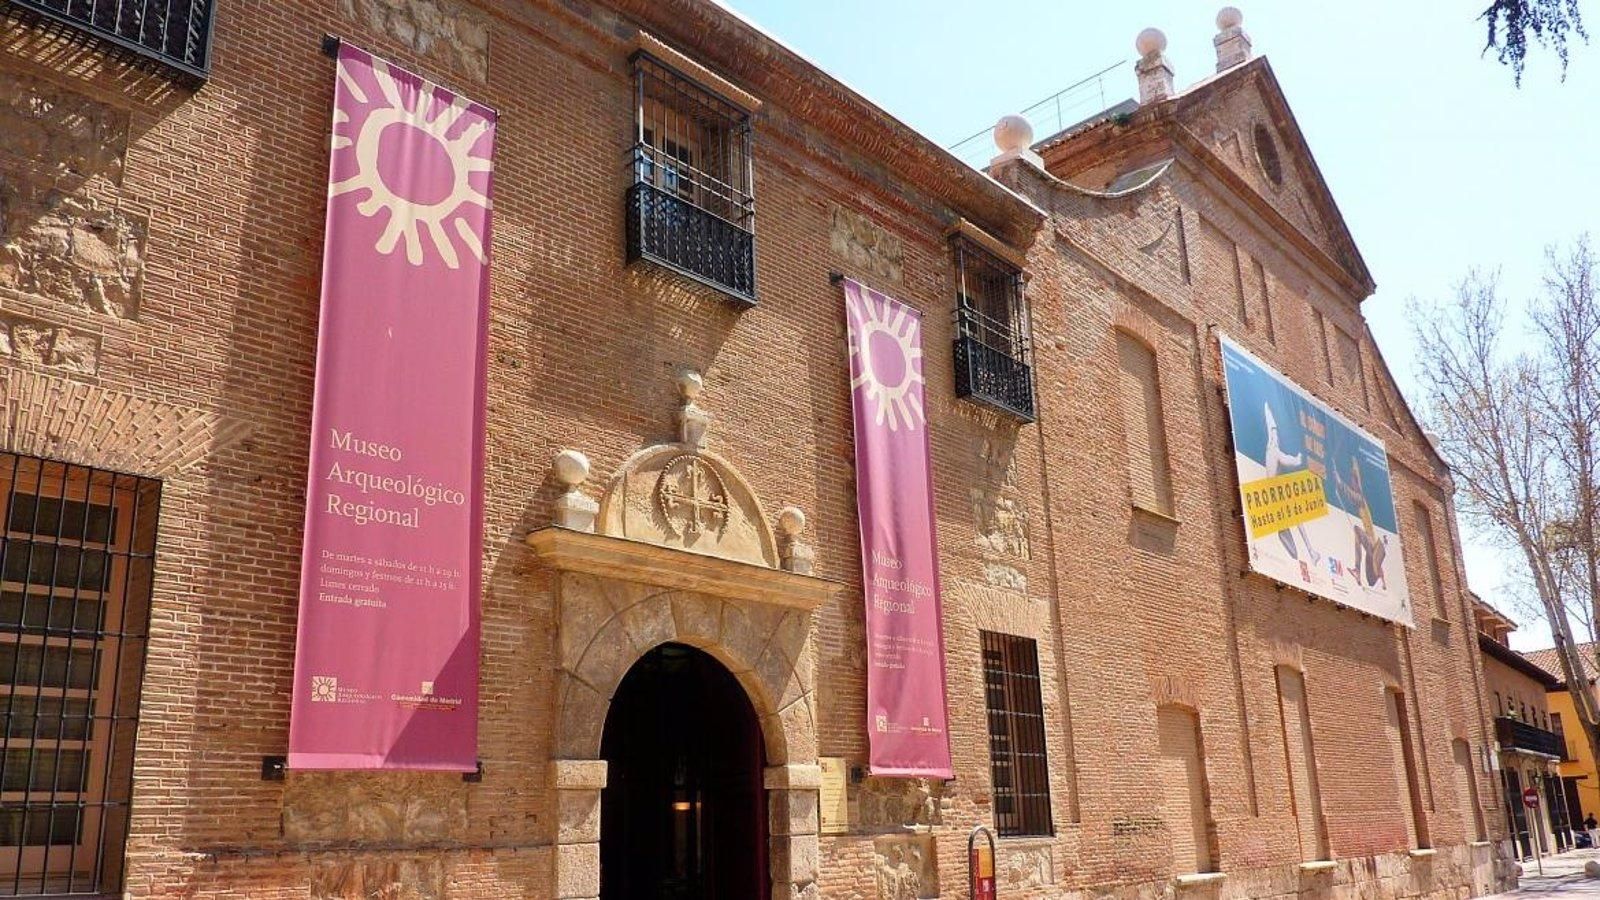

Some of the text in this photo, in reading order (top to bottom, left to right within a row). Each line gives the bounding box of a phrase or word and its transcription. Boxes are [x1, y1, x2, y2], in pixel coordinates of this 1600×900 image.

[330, 428, 402, 462] Museo
[326, 461, 465, 506] Arqueológico
[1246, 477, 1321, 510] PRORROGADA
[325, 493, 419, 528] Regional
[1251, 512, 1275, 528] Hasta
[1278, 508, 1285, 521] el
[1293, 502, 1303, 515] de
[1305, 496, 1325, 512] Junio
[321, 549, 335, 560] De
[336, 553, 366, 565] martes
[374, 557, 406, 570] sábados
[407, 561, 417, 572] de
[872, 550, 903, 569] Museo
[319, 563, 363, 578] domingos
[364, 571, 370, 580] y
[371, 570, 402, 583] festivos
[404, 574, 416, 585] de
[319, 577, 380, 593] Lunes cerrado
[873, 572, 931, 599] Arqueológico
[319, 592, 387, 608] Entrada gratuita
[873, 593, 915, 616] Regional
